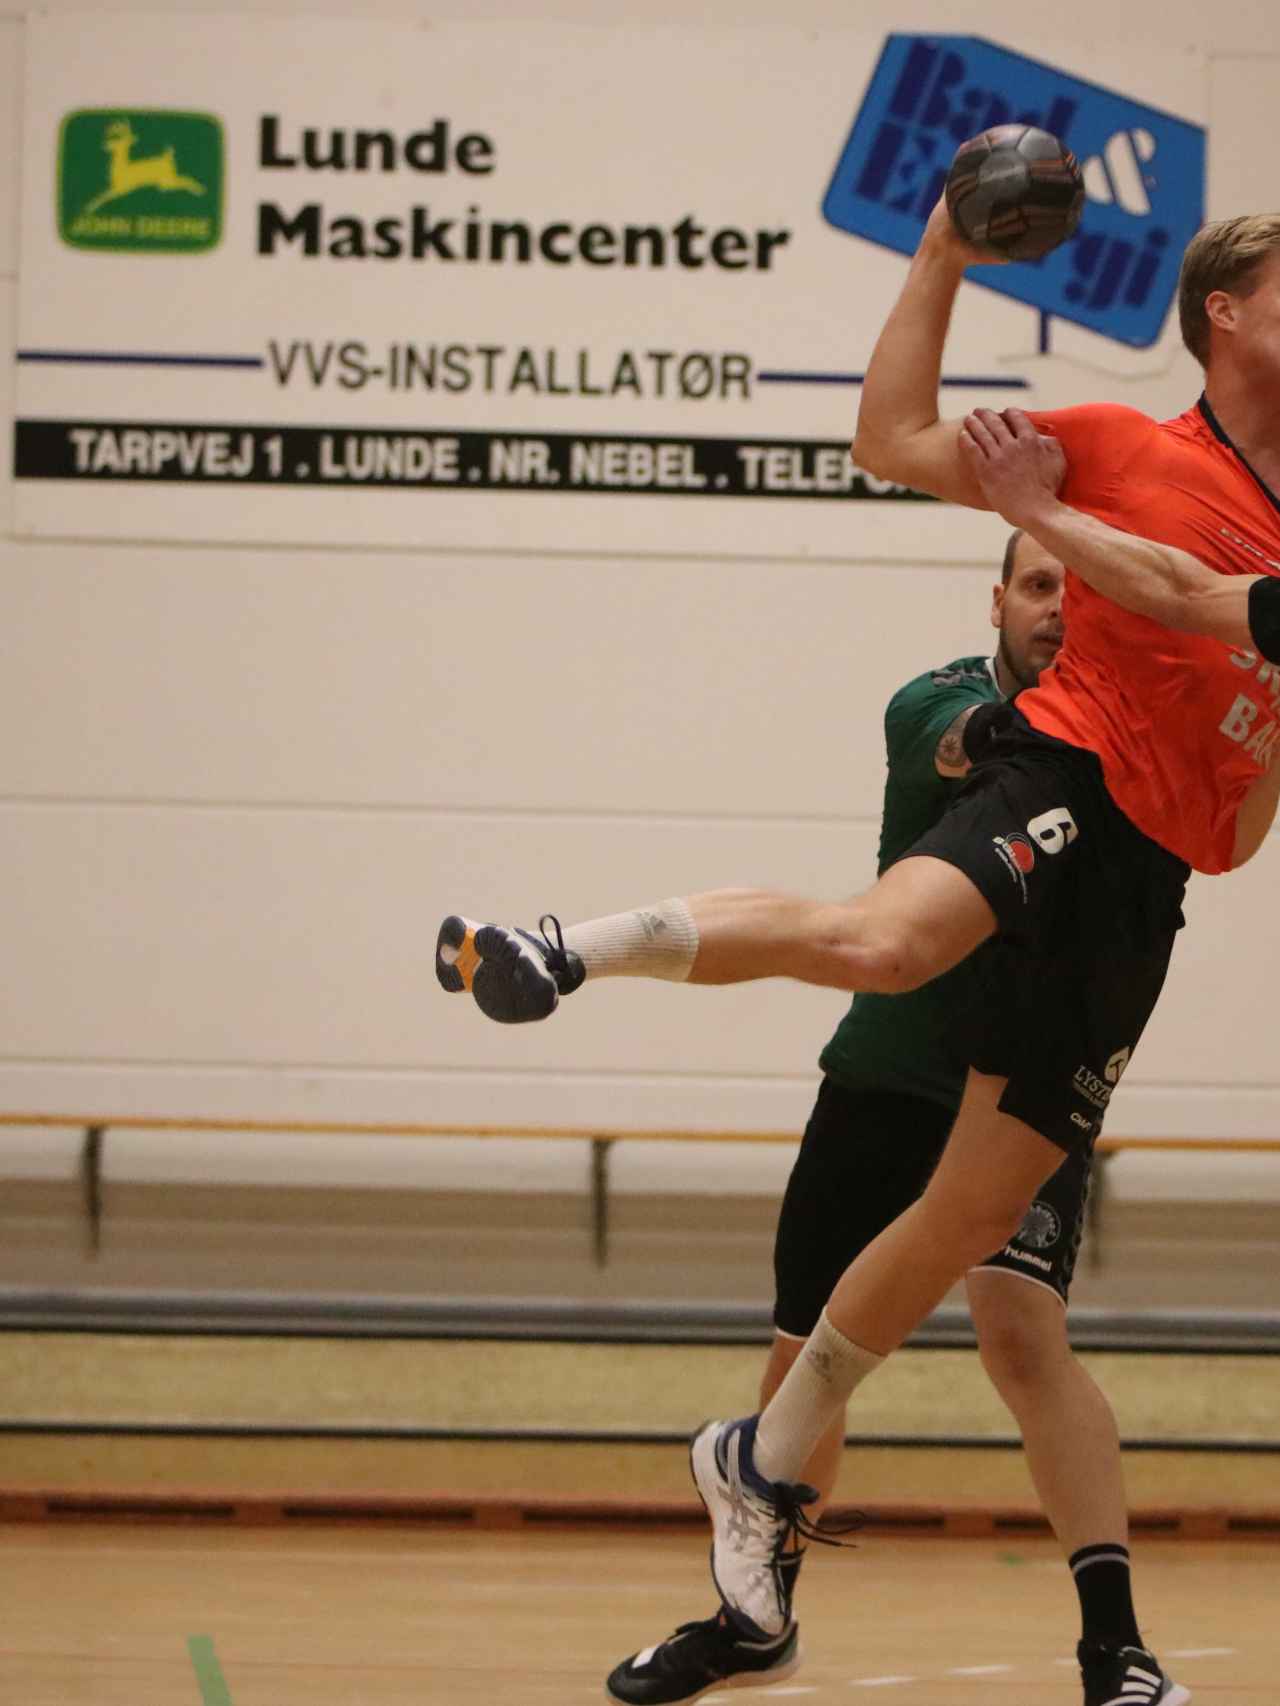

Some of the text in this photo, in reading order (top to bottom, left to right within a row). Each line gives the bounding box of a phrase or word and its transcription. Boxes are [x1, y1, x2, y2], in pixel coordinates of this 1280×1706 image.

[259, 114, 495, 174] Lunde
[70, 216, 212, 238] JOHN DEERE
[257, 203, 790, 270] Maskincenter
[269, 340, 753, 401] VVS-INSTALLATØR
[69, 428, 254, 477] TARPVEJ
[319, 434, 459, 481] LUNDE
[490, 440, 559, 483] NR.
[570, 442, 706, 487] NEBEL
[1027, 806, 1079, 855] 6
